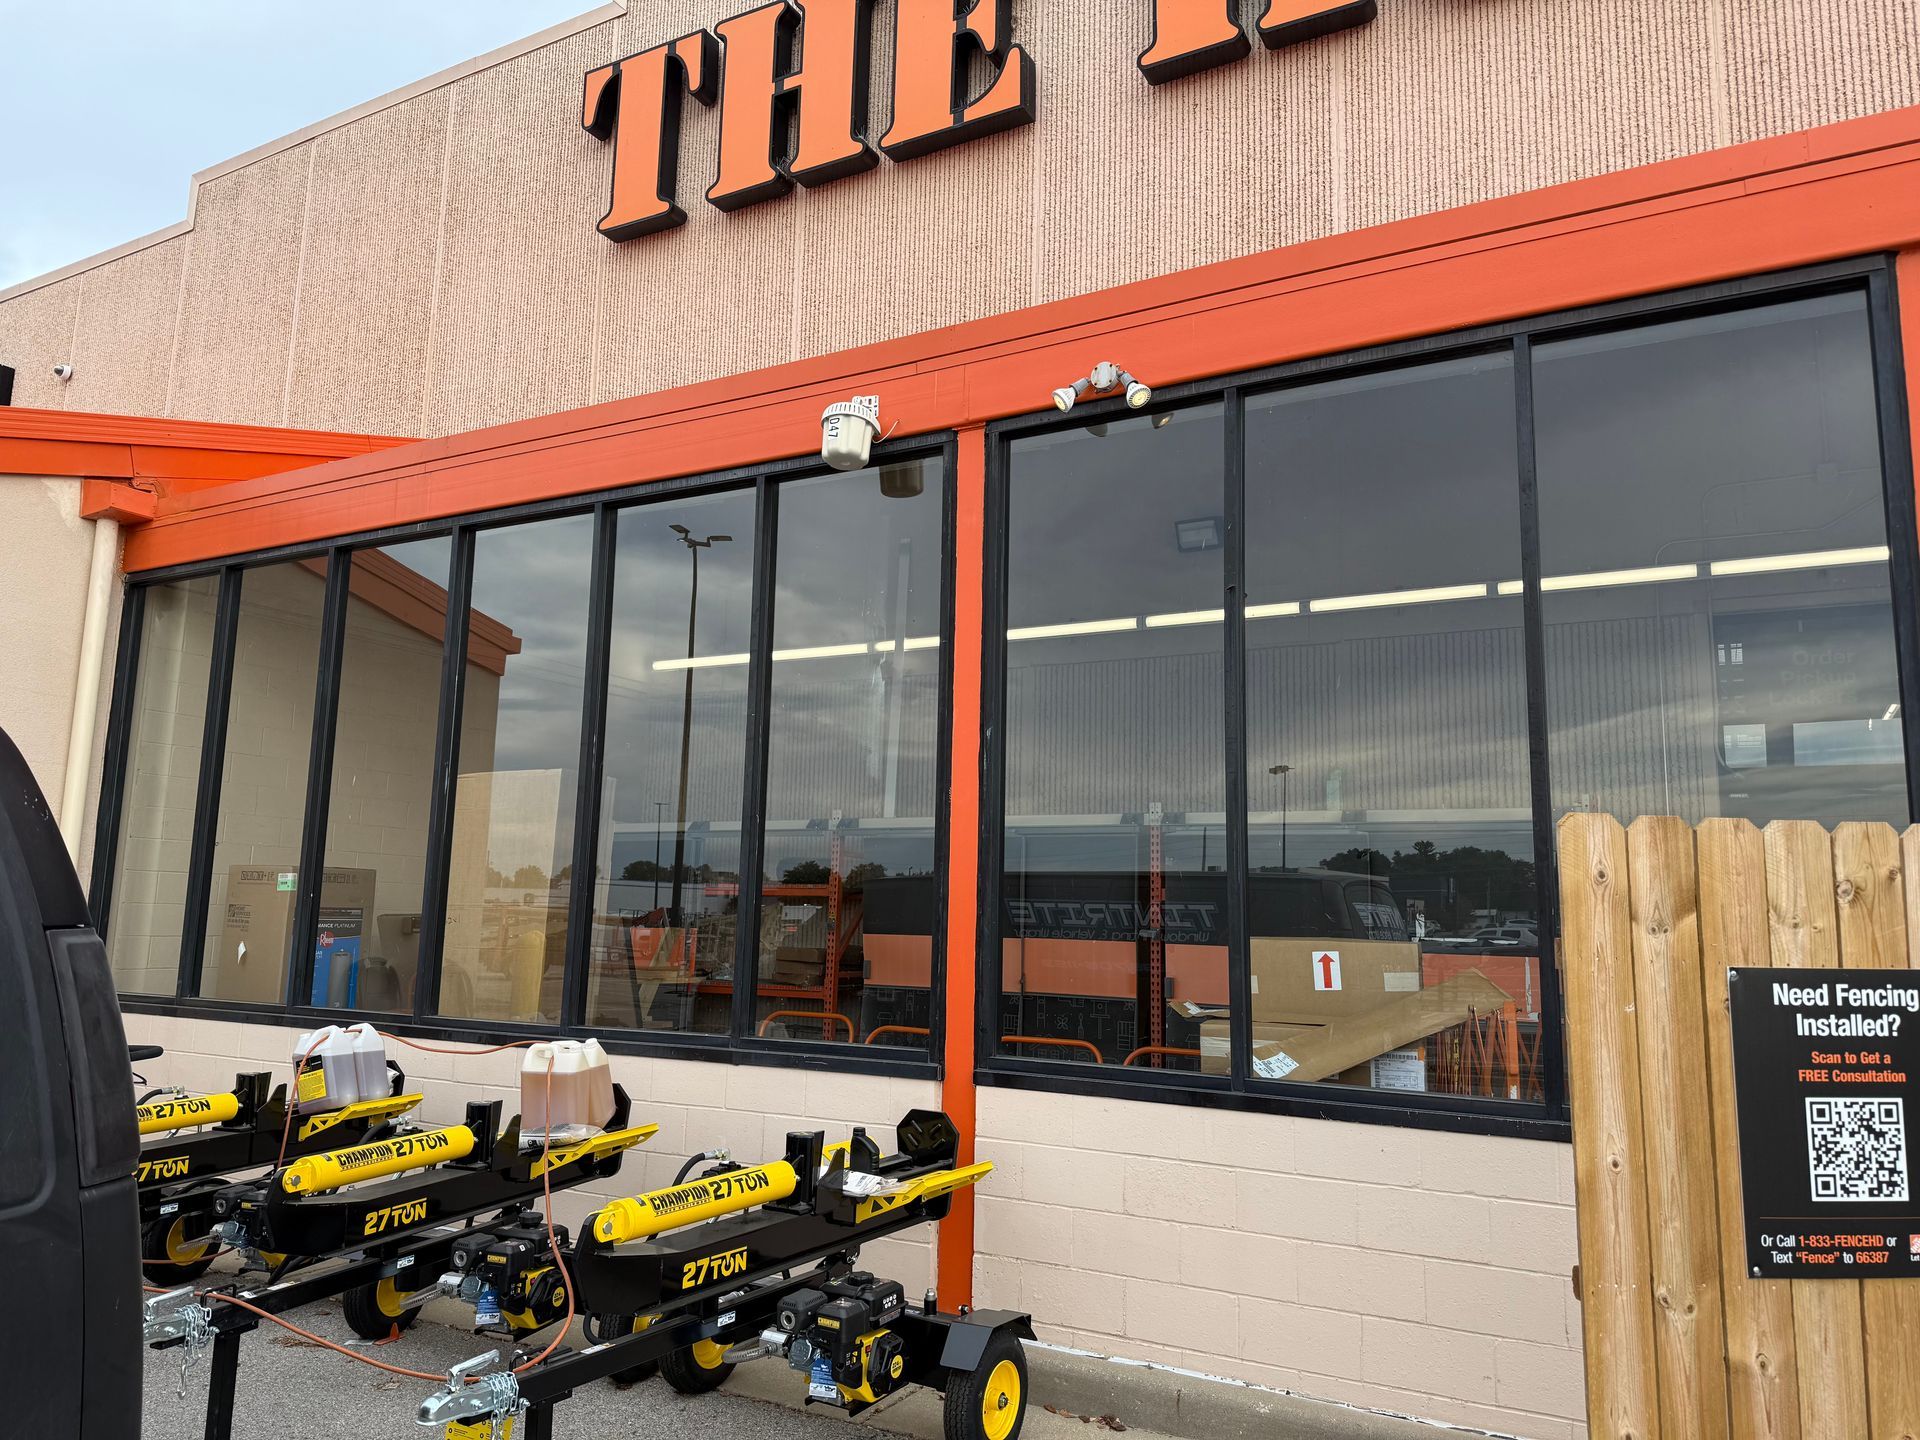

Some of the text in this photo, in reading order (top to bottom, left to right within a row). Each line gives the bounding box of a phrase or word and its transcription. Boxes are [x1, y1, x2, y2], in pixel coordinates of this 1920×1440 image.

[581, 0, 1036, 243] THE
[1772, 983, 1920, 1012] Need Fencing
[1796, 1013, 1901, 1037] Installed?
[1811, 1052, 1891, 1064] Scan to Get a
[1798, 1069, 1907, 1083] FREE Consultation
[153, 1103, 175, 1119] 27
[337, 1143, 393, 1166] CHAMPION
[392, 1138, 414, 1157] 27
[650, 1184, 710, 1211] CHAMPION
[708, 1177, 732, 1200] 27
[1761, 1234, 1897, 1247] Or Call 1-833-FENCEHD or
[1771, 1250, 1793, 1263] Text
[1843, 1252, 1854, 1264] to
[1856, 1251, 1889, 1264] 66387
